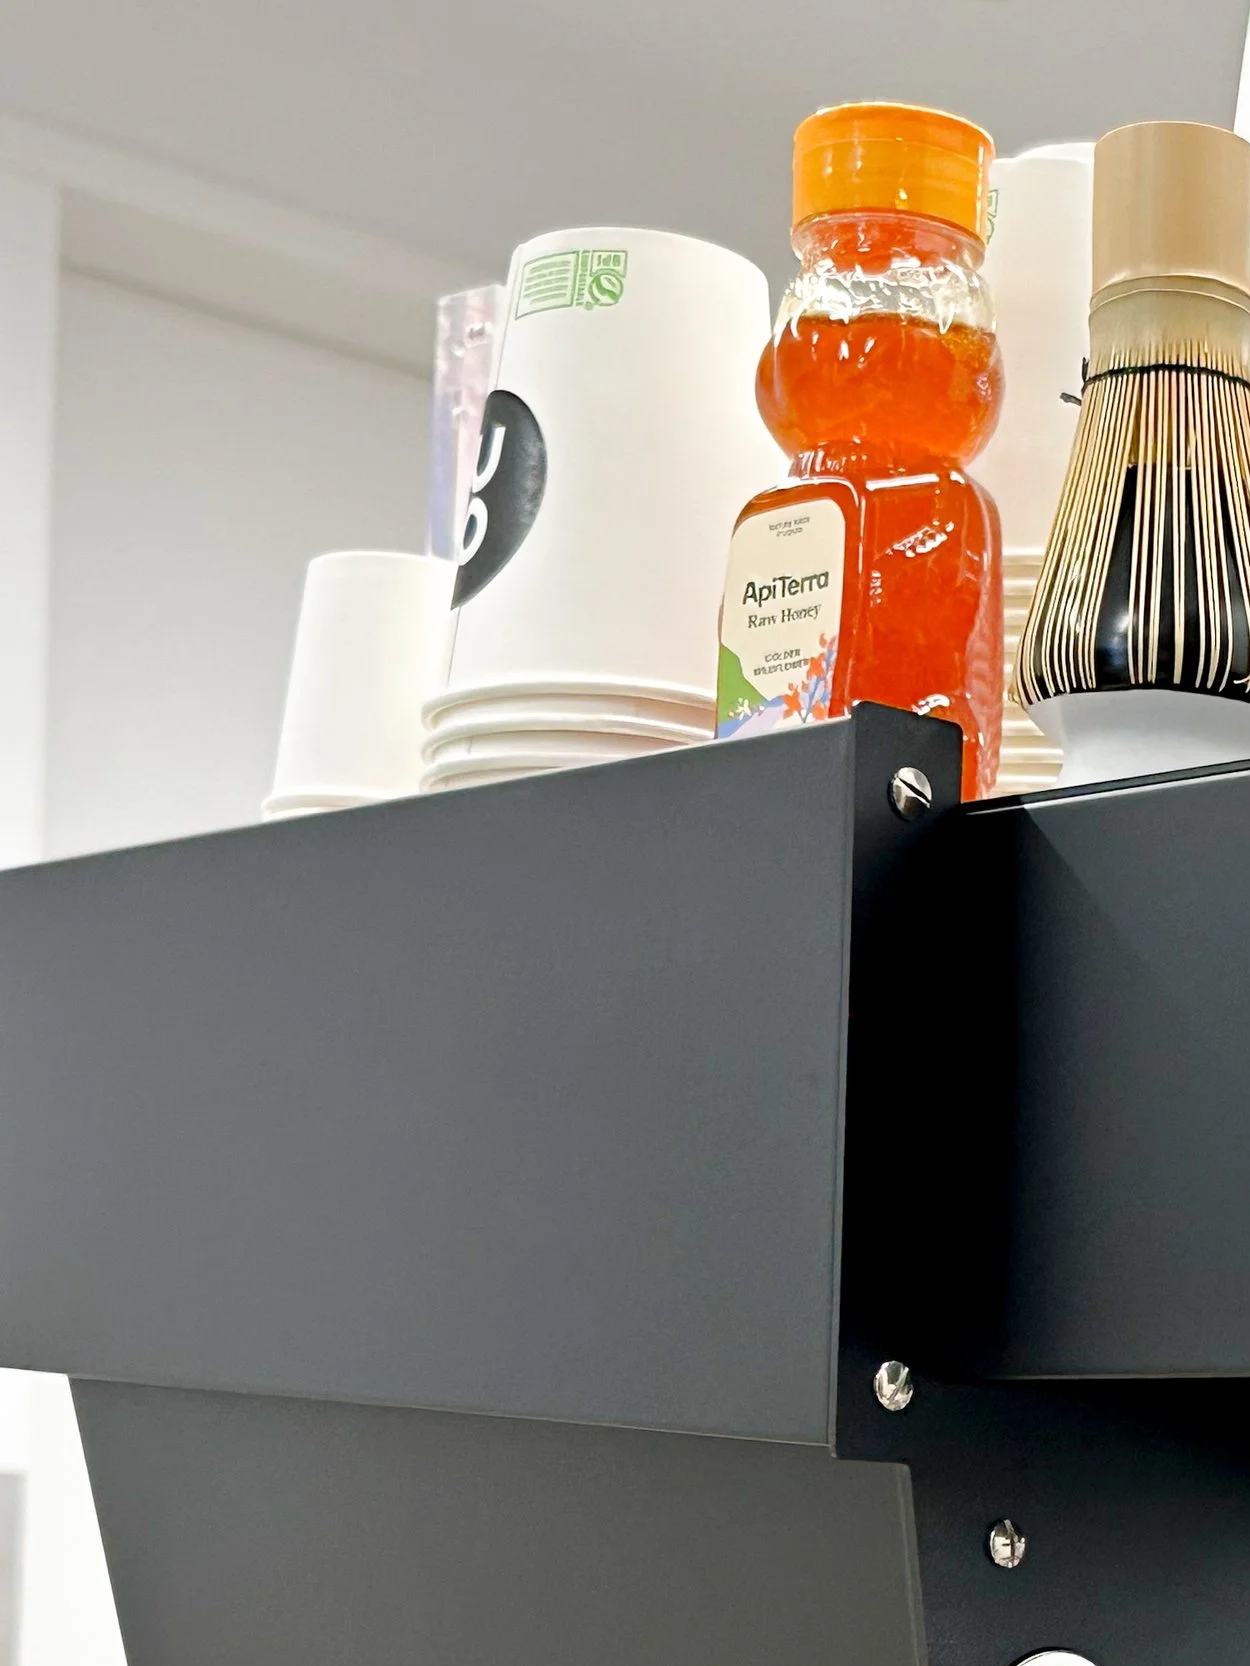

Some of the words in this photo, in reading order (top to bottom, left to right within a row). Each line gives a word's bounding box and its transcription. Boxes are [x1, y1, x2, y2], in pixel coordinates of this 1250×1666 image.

[741, 571, 830, 608] ApiTerra
[748, 613, 777, 629] Raw
[781, 603, 822, 624] Honey
